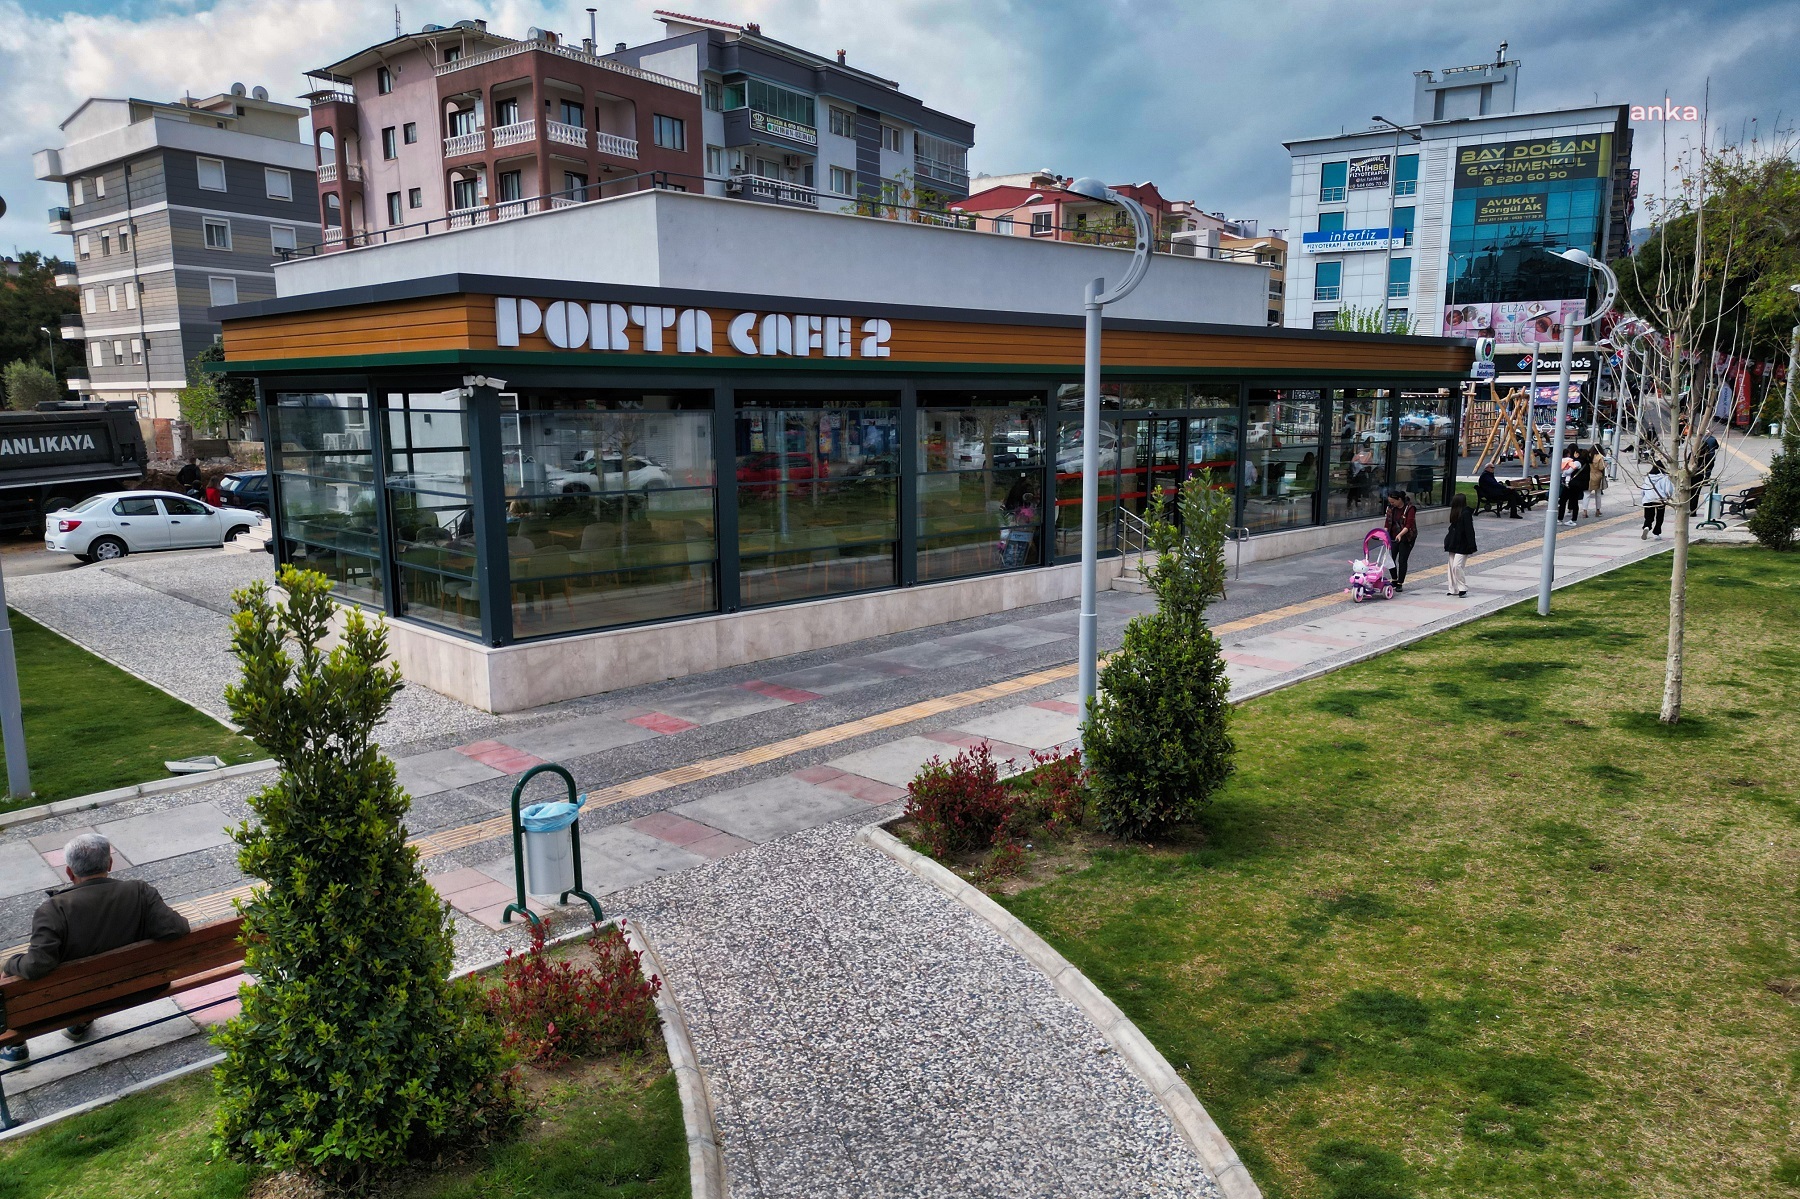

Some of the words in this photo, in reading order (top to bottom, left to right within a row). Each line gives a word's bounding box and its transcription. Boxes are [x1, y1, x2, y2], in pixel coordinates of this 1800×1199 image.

[1461, 147, 1506, 162] BAY
[1513, 139, 1596, 158] DOĞAN
[1466, 157, 1587, 176] GAYRİMENKUL
[1496, 174, 1523, 184] 220
[1527, 173, 1545, 181] 60
[1549, 171, 1567, 179] 90
[1487, 196, 1537, 207] AVUKAT
[1481, 205, 1521, 214] Songül
[1524, 203, 1542, 211] AK
[1329, 229, 1376, 242] interfiz
[1500, 303, 1525, 314] ELZA
[494, 296, 713, 355] PORTA
[727, 311, 852, 358] CAFE
[860, 318, 892, 358] 2
